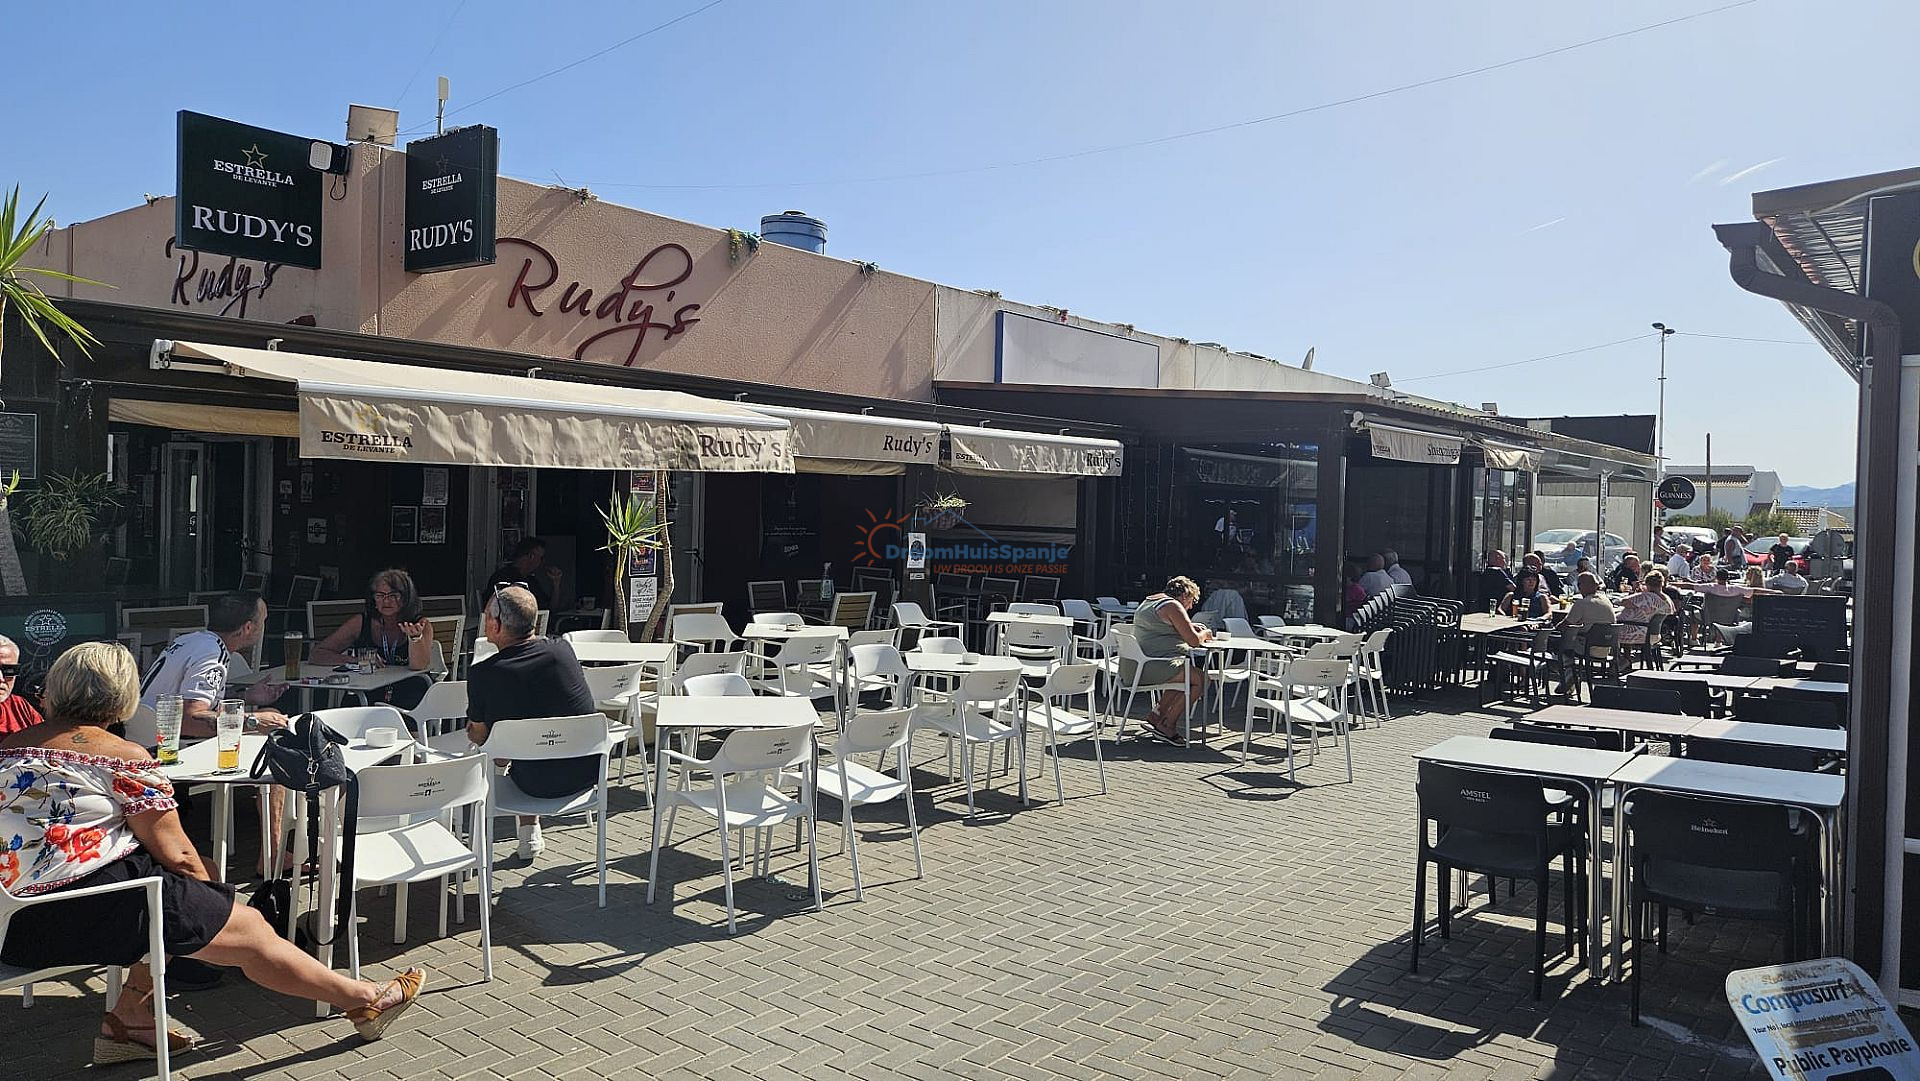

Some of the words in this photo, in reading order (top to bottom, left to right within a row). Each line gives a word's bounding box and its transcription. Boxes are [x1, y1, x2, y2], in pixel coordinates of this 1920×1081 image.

[213, 159, 295, 186] ESTRELLA
[232, 173, 244, 182] DE
[244, 176, 278, 188] LEVANTE
[422, 172, 463, 190] ESTRELLA
[192, 204, 314, 247] RUDY'S
[410, 219, 473, 251] RUDY'S
[496, 237, 701, 366] Rudy's
[320, 430, 413, 448] ESTRELLA
[342, 443, 356, 452] DE
[356, 445, 397, 454] LEVANTE
[700, 434, 783, 459] Rudy's
[883, 434, 934, 454] Rudy's
[1660, 491, 1692, 499] GUINNESS
[1460, 788, 1491, 800] AMSTEL
[1741, 978, 1851, 1014] Compusurf
[1773, 1052, 1830, 1076] Public
[1828, 1036, 1912, 1067] Payphone
